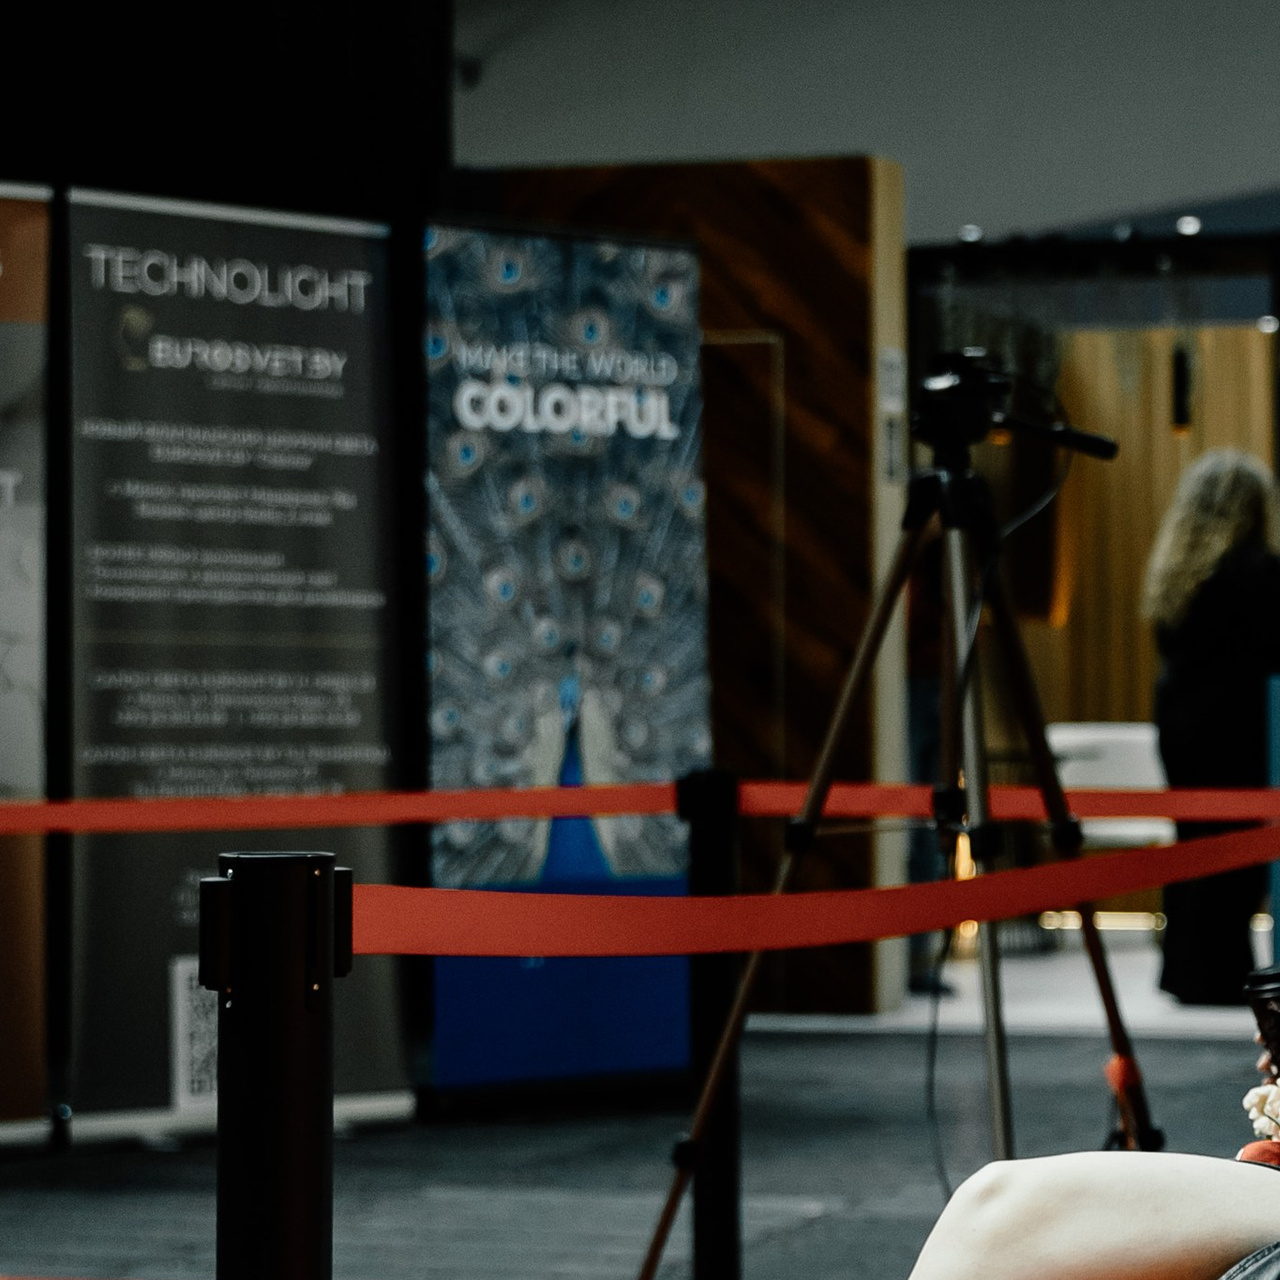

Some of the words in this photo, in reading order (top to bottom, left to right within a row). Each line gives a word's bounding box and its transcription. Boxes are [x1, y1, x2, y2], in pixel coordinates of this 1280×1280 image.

[83, 243, 372, 314] TECHNOLIGHT
[453, 341, 527, 373] MAKE
[531, 341, 581, 380] THE
[583, 347, 679, 387] WORLD
[453, 376, 681, 441] COLORFUL
